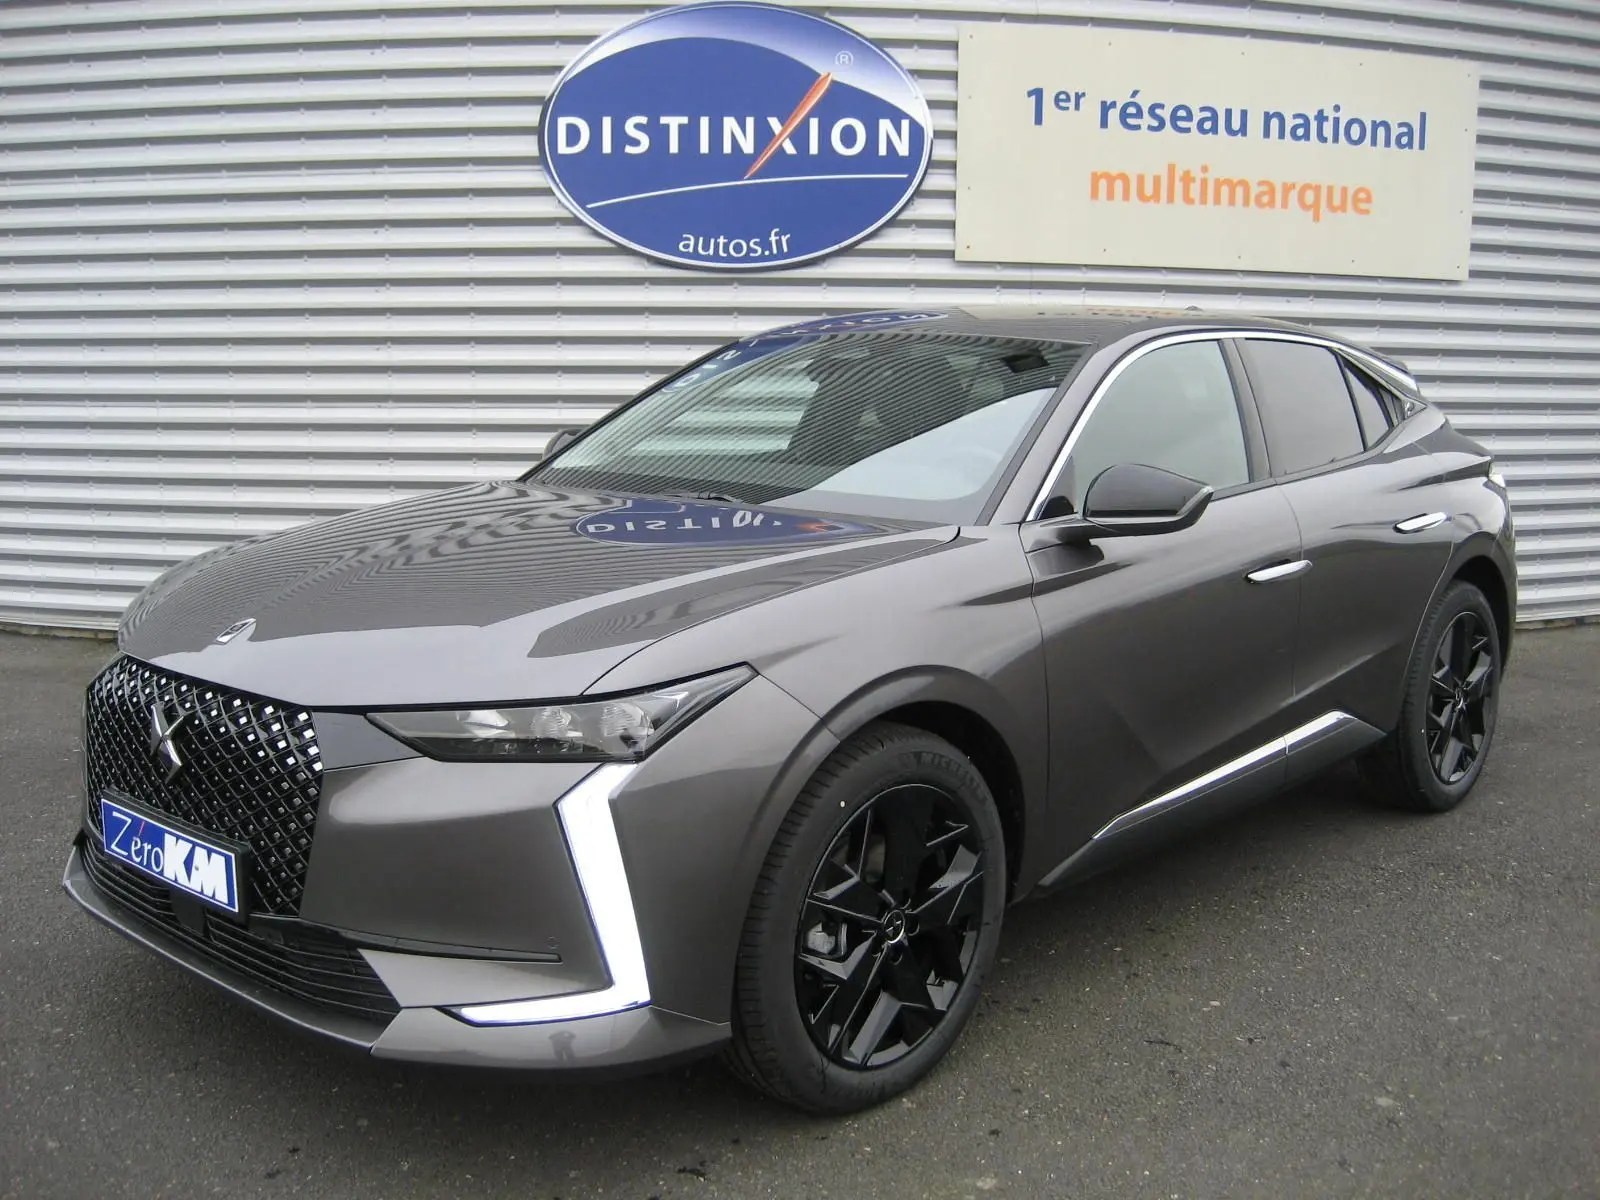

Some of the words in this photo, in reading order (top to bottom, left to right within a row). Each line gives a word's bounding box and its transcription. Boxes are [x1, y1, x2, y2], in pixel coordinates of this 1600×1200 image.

[1099, 89, 1248, 138] réseau
[1262, 104, 1427, 151] national
[1090, 163, 1373, 223] multimarque
[678, 228, 791, 258] autos.fr
